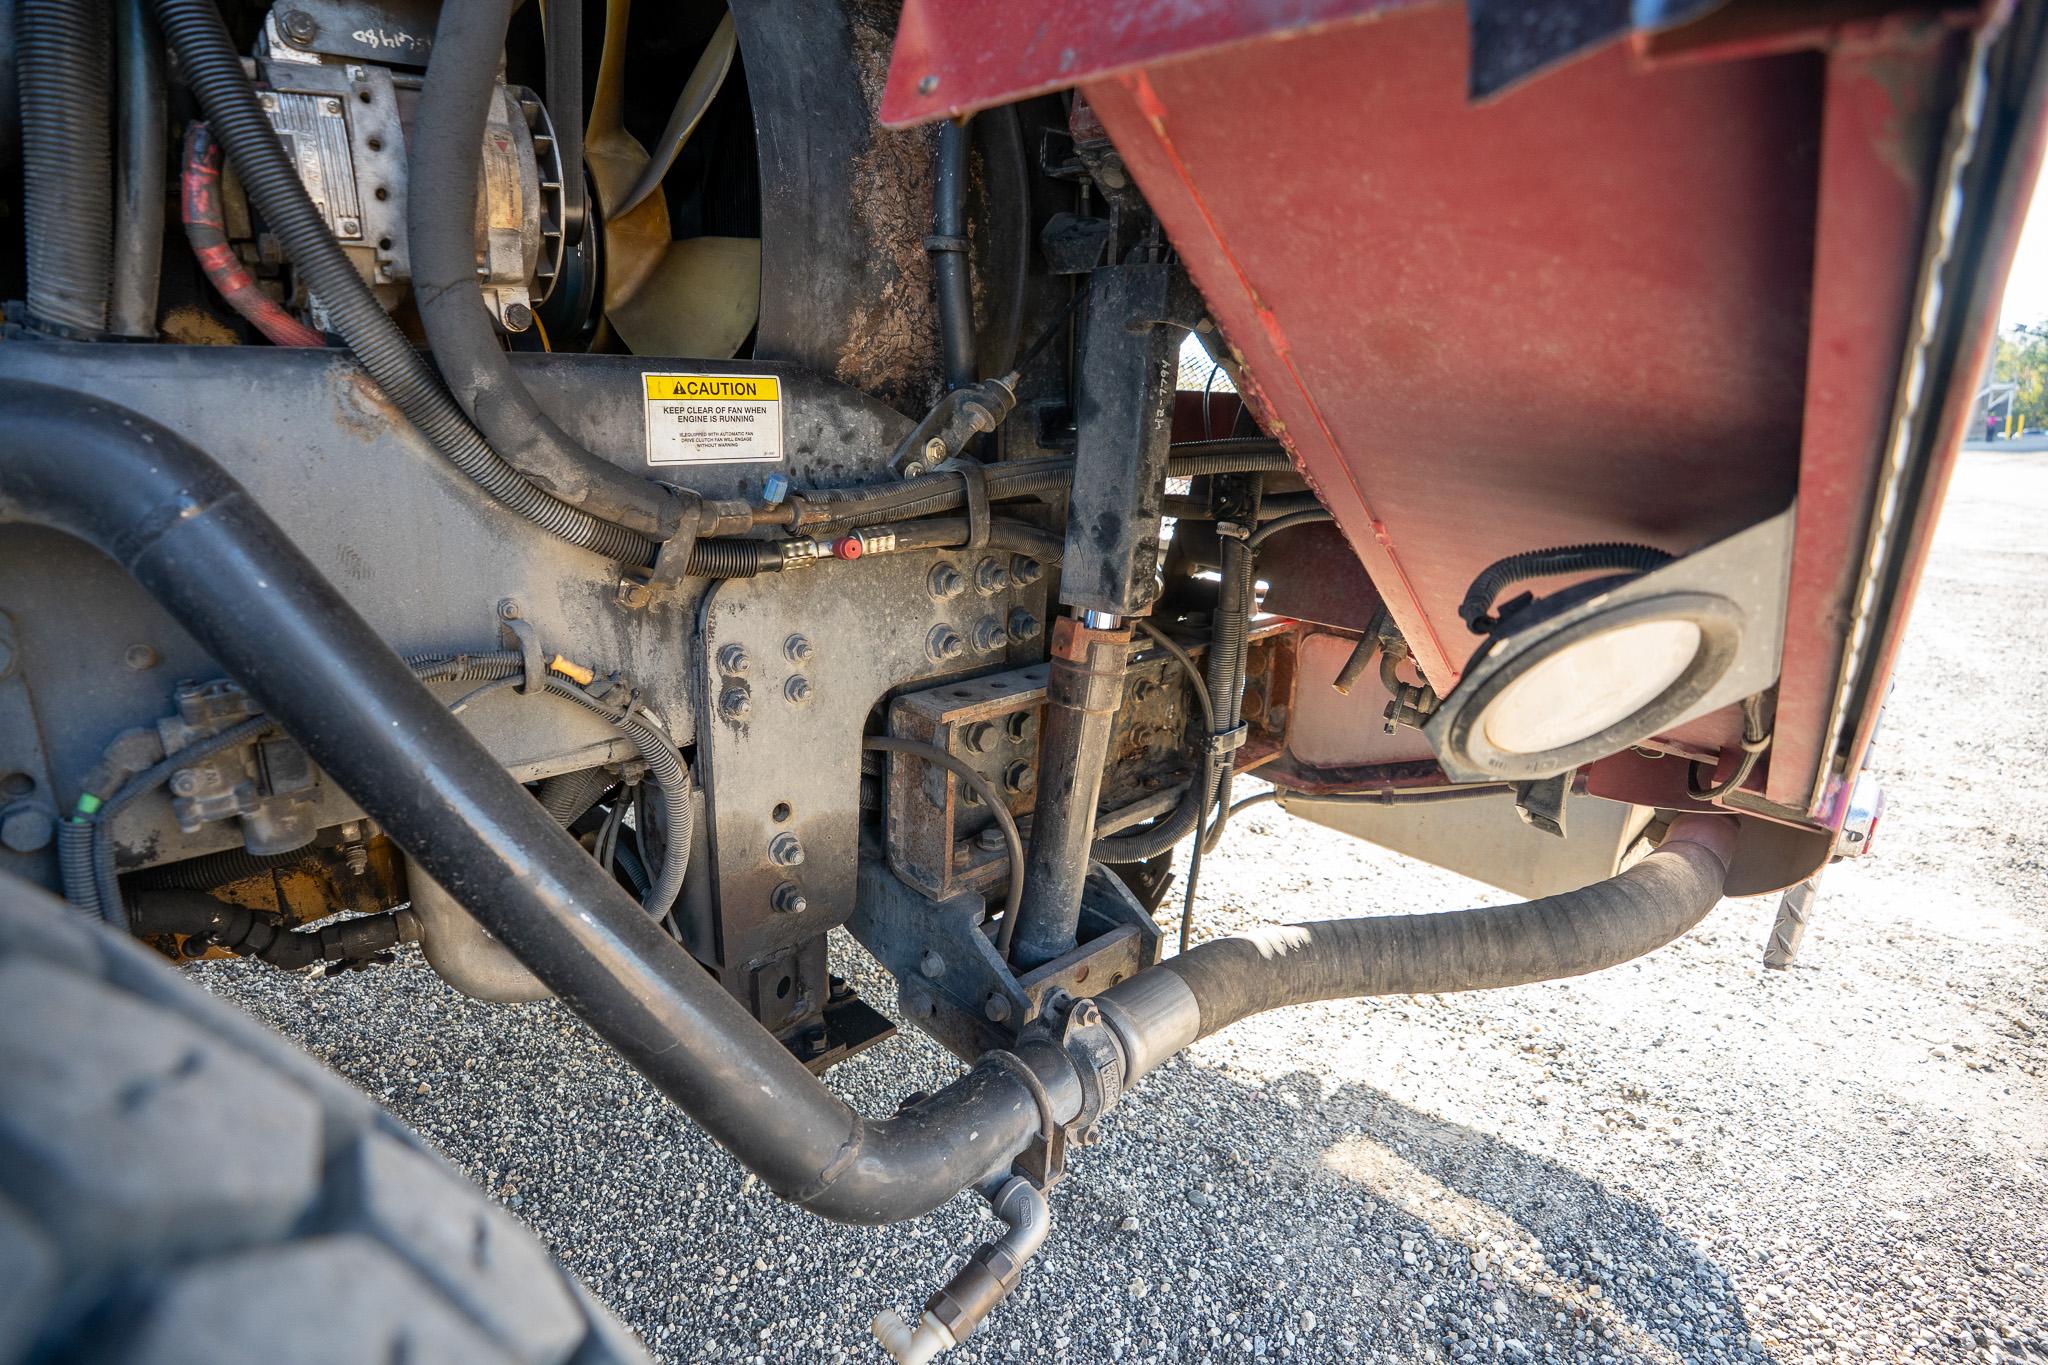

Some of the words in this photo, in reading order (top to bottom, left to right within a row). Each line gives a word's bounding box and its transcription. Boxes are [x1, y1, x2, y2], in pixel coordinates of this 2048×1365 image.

[687, 381, 757, 396] CAUTION
[1154, 359, 1171, 430] 42-7794
[663, 406, 685, 414] KEEP
[687, 406, 714, 414] CLEAR
[715, 406, 726, 414] OF
[728, 406, 743, 414] FAN
[745, 406, 767, 414] WHEN
[678, 415, 708, 423] ENGINE
[710, 415, 718, 423] IS
[720, 415, 754, 423] RUNNING
